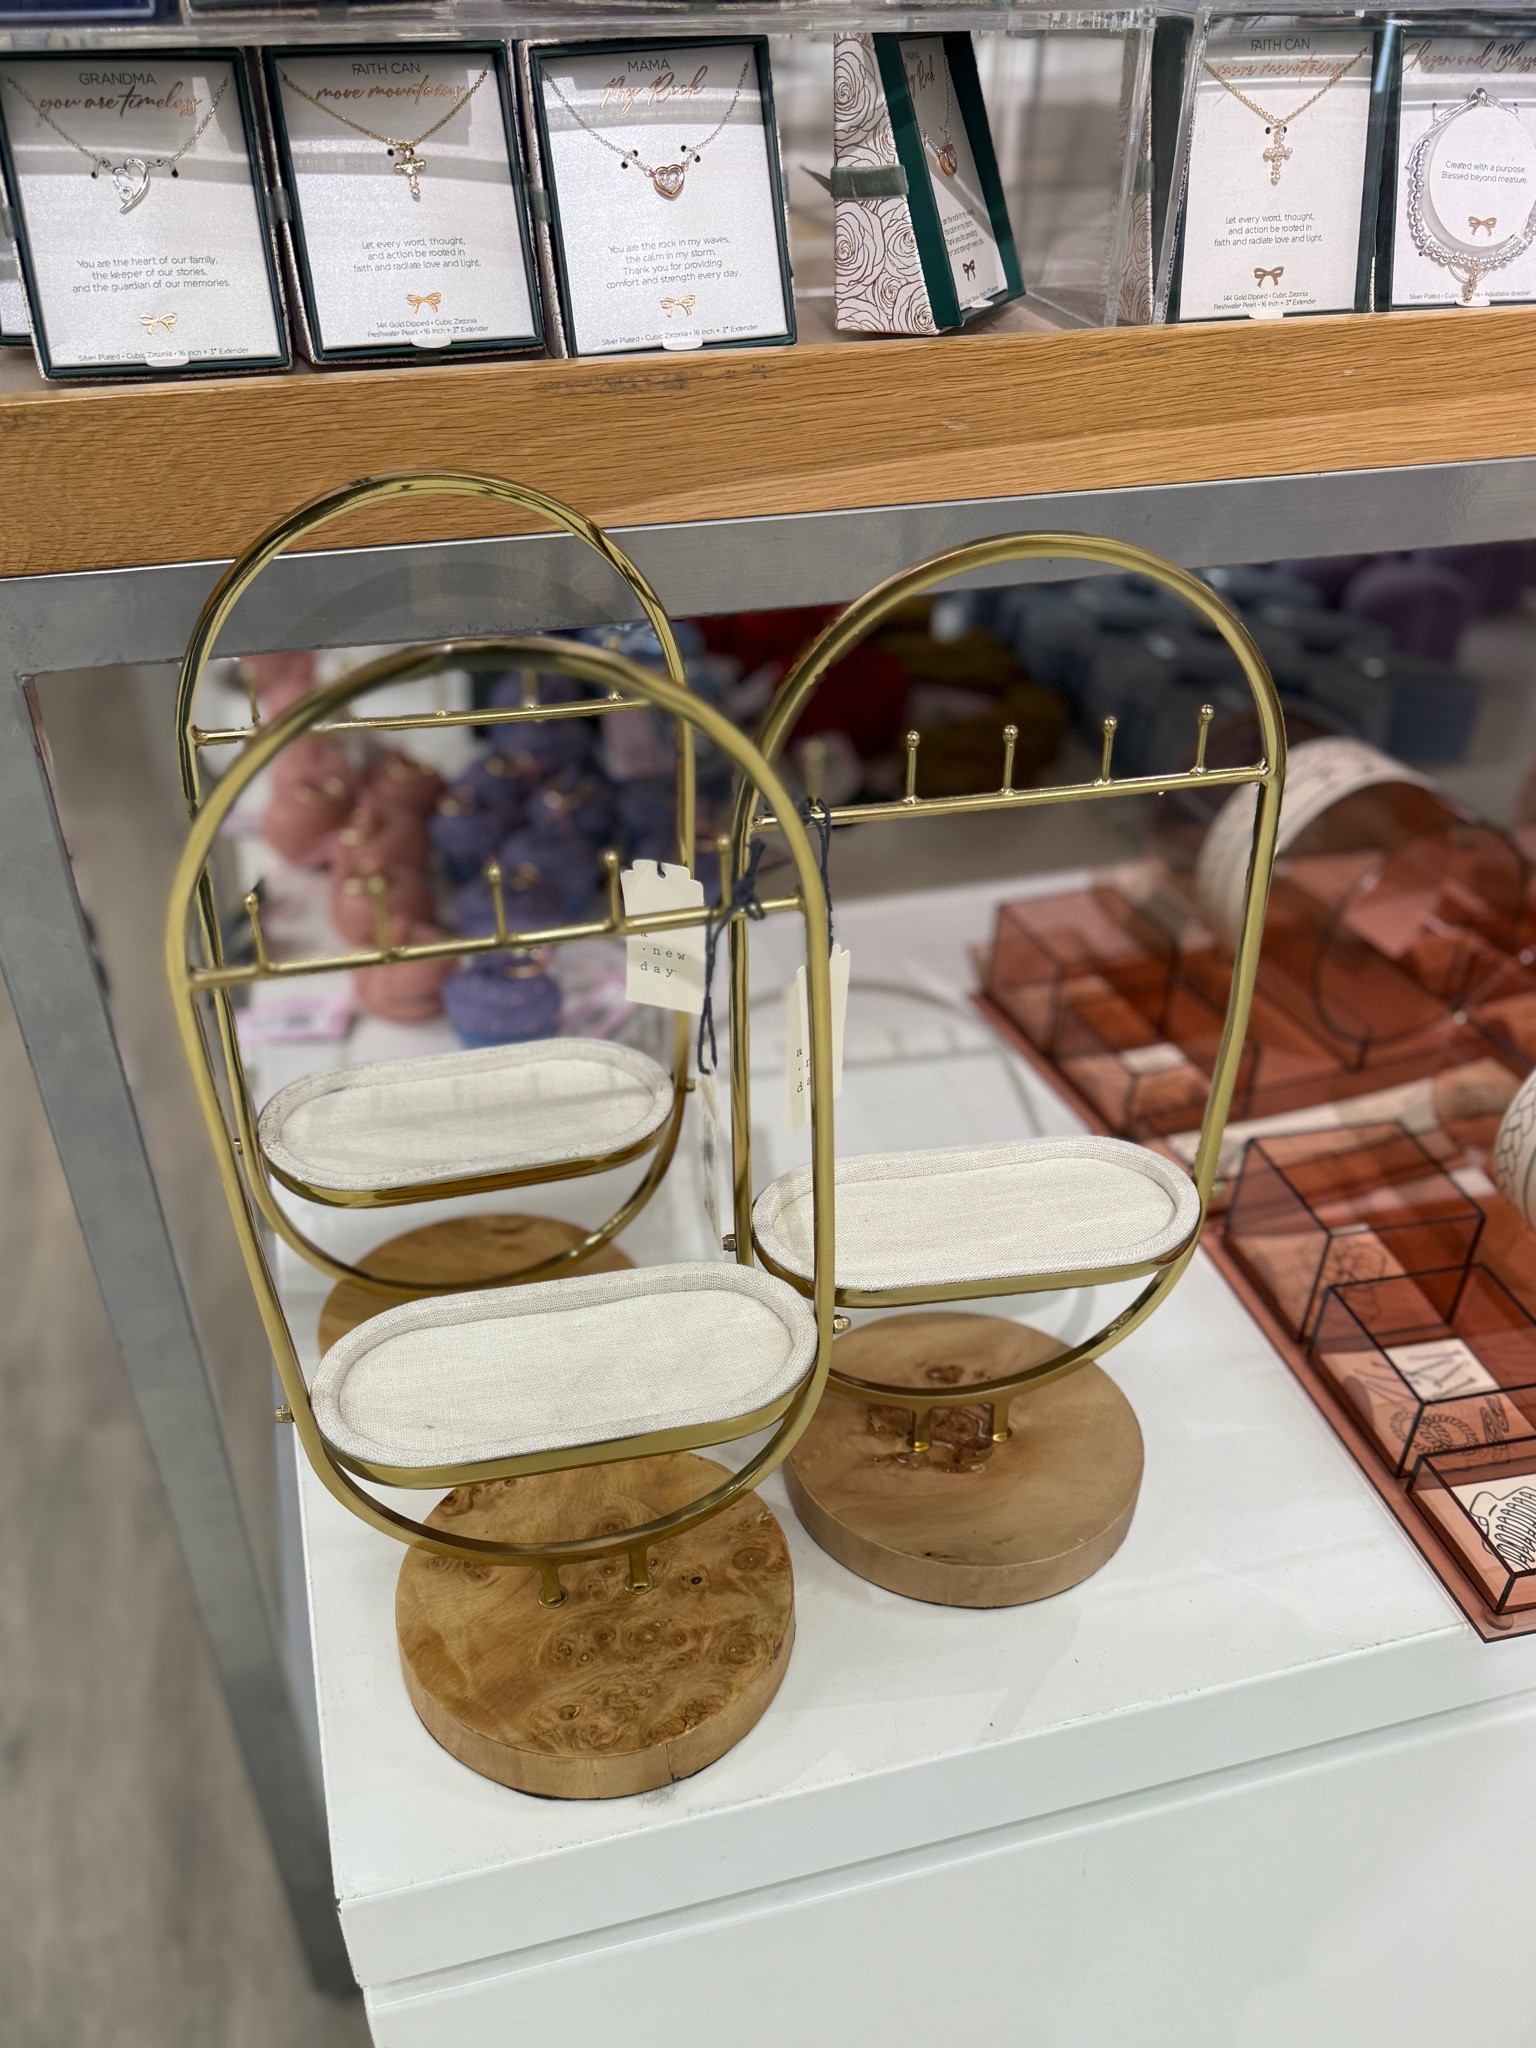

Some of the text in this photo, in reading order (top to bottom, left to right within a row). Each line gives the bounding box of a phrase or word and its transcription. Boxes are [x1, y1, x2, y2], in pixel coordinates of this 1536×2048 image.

[1251, 38, 1310, 51] FAITH CAN
[352, 62, 421, 76] FAITH CAN
[627, 59, 671, 73] MAMA
[79, 73, 157, 85] GRANDMA
[316, 75, 464, 105] move mountains
[600, 64, 708, 116] My Rock
[84, 98, 119, 110] are
[118, 81, 203, 117] timeless
[1445, 161, 1471, 170] Created
[1474, 161, 1488, 171] with
[1441, 171, 1469, 181] Blessed
[1470, 173, 1497, 183] beyond
[1225, 216, 1236, 224] Let
[1238, 216, 1260, 224] every
[1284, 213, 1314, 221] thought,
[1228, 227, 1243, 235] and
[1282, 224, 1305, 232] rooted
[362, 237, 466, 250] Let every word, thought,
[608, 245, 624, 254] You
[641, 242, 656, 251] the
[658, 240, 676, 249] rock
[688, 239, 700, 247] my
[1214, 239, 1231, 247] faith
[1232, 238, 1247, 246] and
[1249, 236, 1273, 245] radiate
[1275, 236, 1289, 244] love
[367, 252, 384, 260] and
[387, 250, 414, 259] action
[429, 249, 456, 257] rooted
[458, 248, 465, 256] in
[626, 255, 641, 264] the
[643, 254, 664, 262] calm
[666, 252, 674, 260] in
[675, 252, 688, 260] my
[77, 260, 95, 268] You
[113, 258, 129, 267] the
[131, 257, 157, 266] heart
[159, 256, 168, 265] of
[171, 257, 186, 265] our
[190, 256, 218, 265] family,
[353, 264, 373, 273] faith
[374, 263, 391, 272] and
[393, 262, 421, 270] radiate
[423, 260, 440, 268] love
[443, 260, 459, 268] and
[623, 259, 723, 276] Thank you for providing
[92, 271, 109, 279] the
[111, 270, 142, 280] keeper
[146, 269, 155, 277] of
[177, 268, 208, 277] stories,
[606, 278, 640, 289] comfort
[642, 276, 659, 285] and
[660, 273, 696, 284] strength
[698, 272, 721, 280] every
[73, 284, 91, 293] and
[93, 283, 109, 292] the
[112, 281, 151, 293] guardian
[153, 279, 162, 288] of
[183, 279, 231, 287] memories.
[640, 962, 674, 977] day
